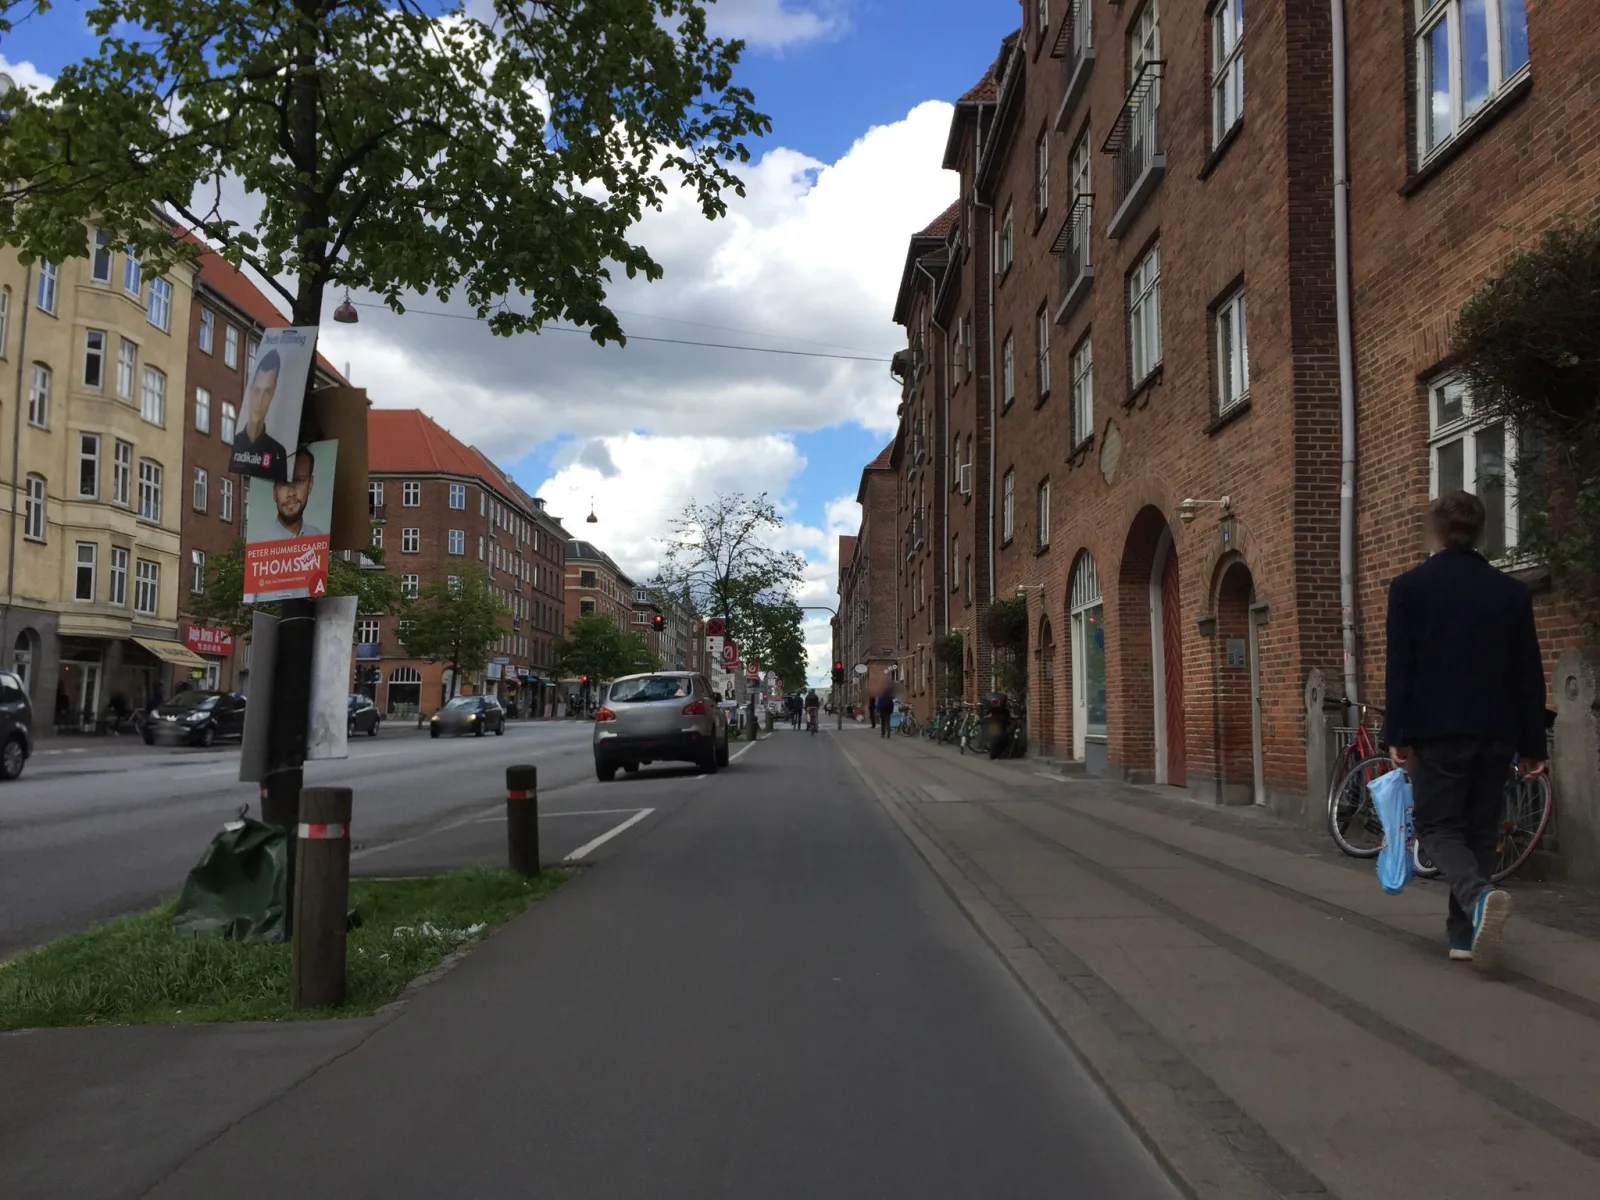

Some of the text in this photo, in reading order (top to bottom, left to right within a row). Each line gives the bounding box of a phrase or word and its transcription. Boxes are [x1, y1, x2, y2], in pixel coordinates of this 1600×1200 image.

[233, 451, 262, 465] radikale
[247, 541, 328, 559] PETER HUMMELGAARD
[314, 578, 325, 594] A
